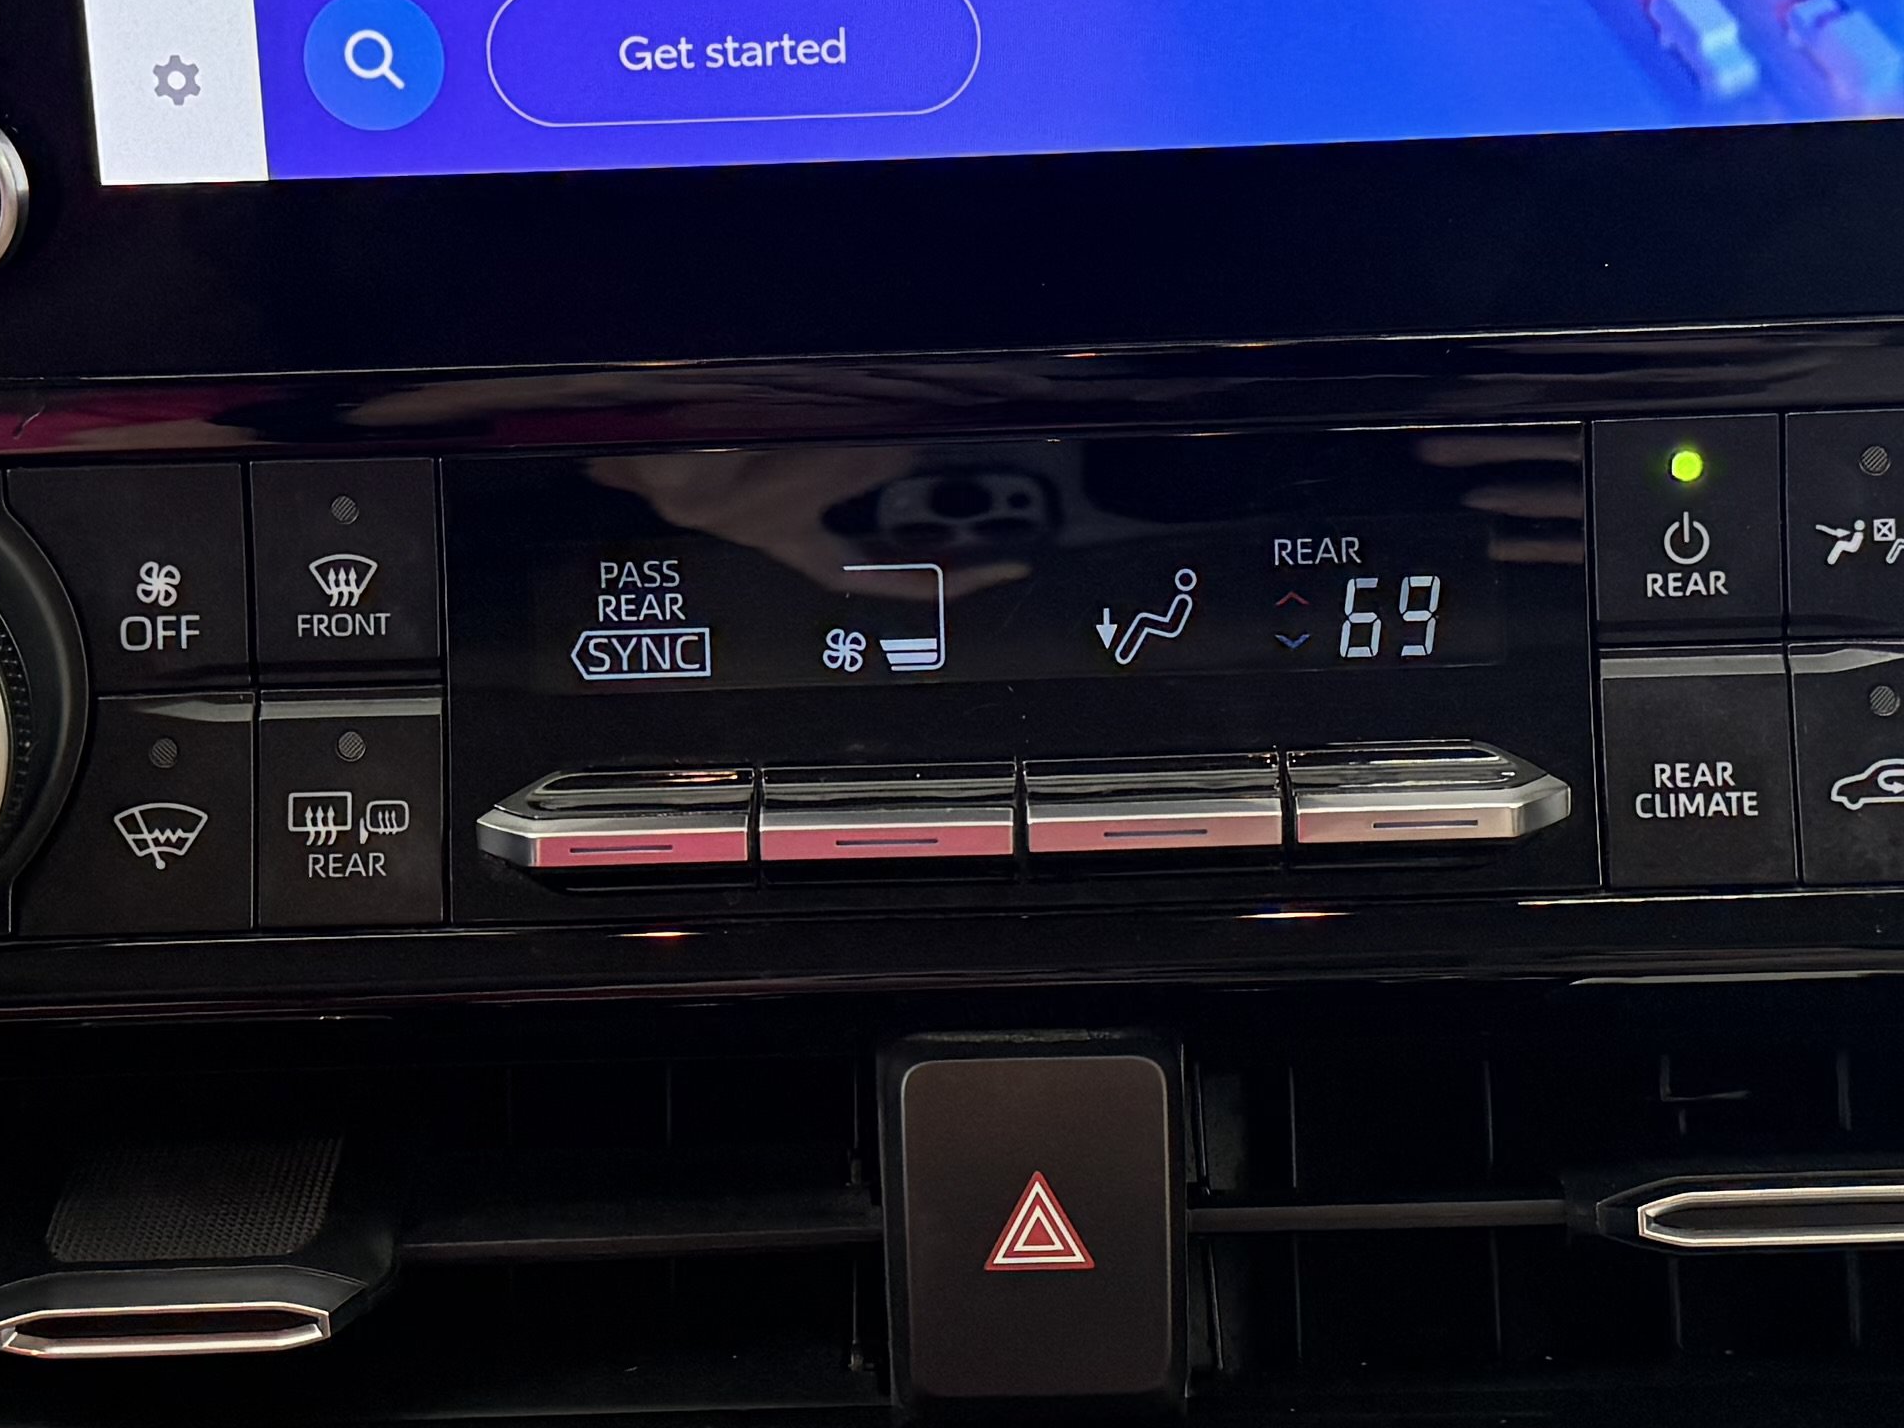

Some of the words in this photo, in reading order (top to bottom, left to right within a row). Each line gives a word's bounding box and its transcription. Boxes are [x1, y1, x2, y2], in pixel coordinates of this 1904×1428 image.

[618, 33, 693, 72] Get
[705, 27, 847, 70] started
[1274, 537, 1362, 566] REAR
[600, 560, 680, 589] PASS
[1645, 569, 1728, 599] REAR
[598, 593, 686, 622] REAR
[1339, 575, 1441, 658] 69
[119, 615, 201, 653] OFF
[296, 611, 390, 639] FRONT
[588, 635, 700, 672] SYNC
[1653, 760, 1737, 791] REAR
[1634, 788, 1759, 820] CLIMATE
[306, 850, 387, 880] REAR
